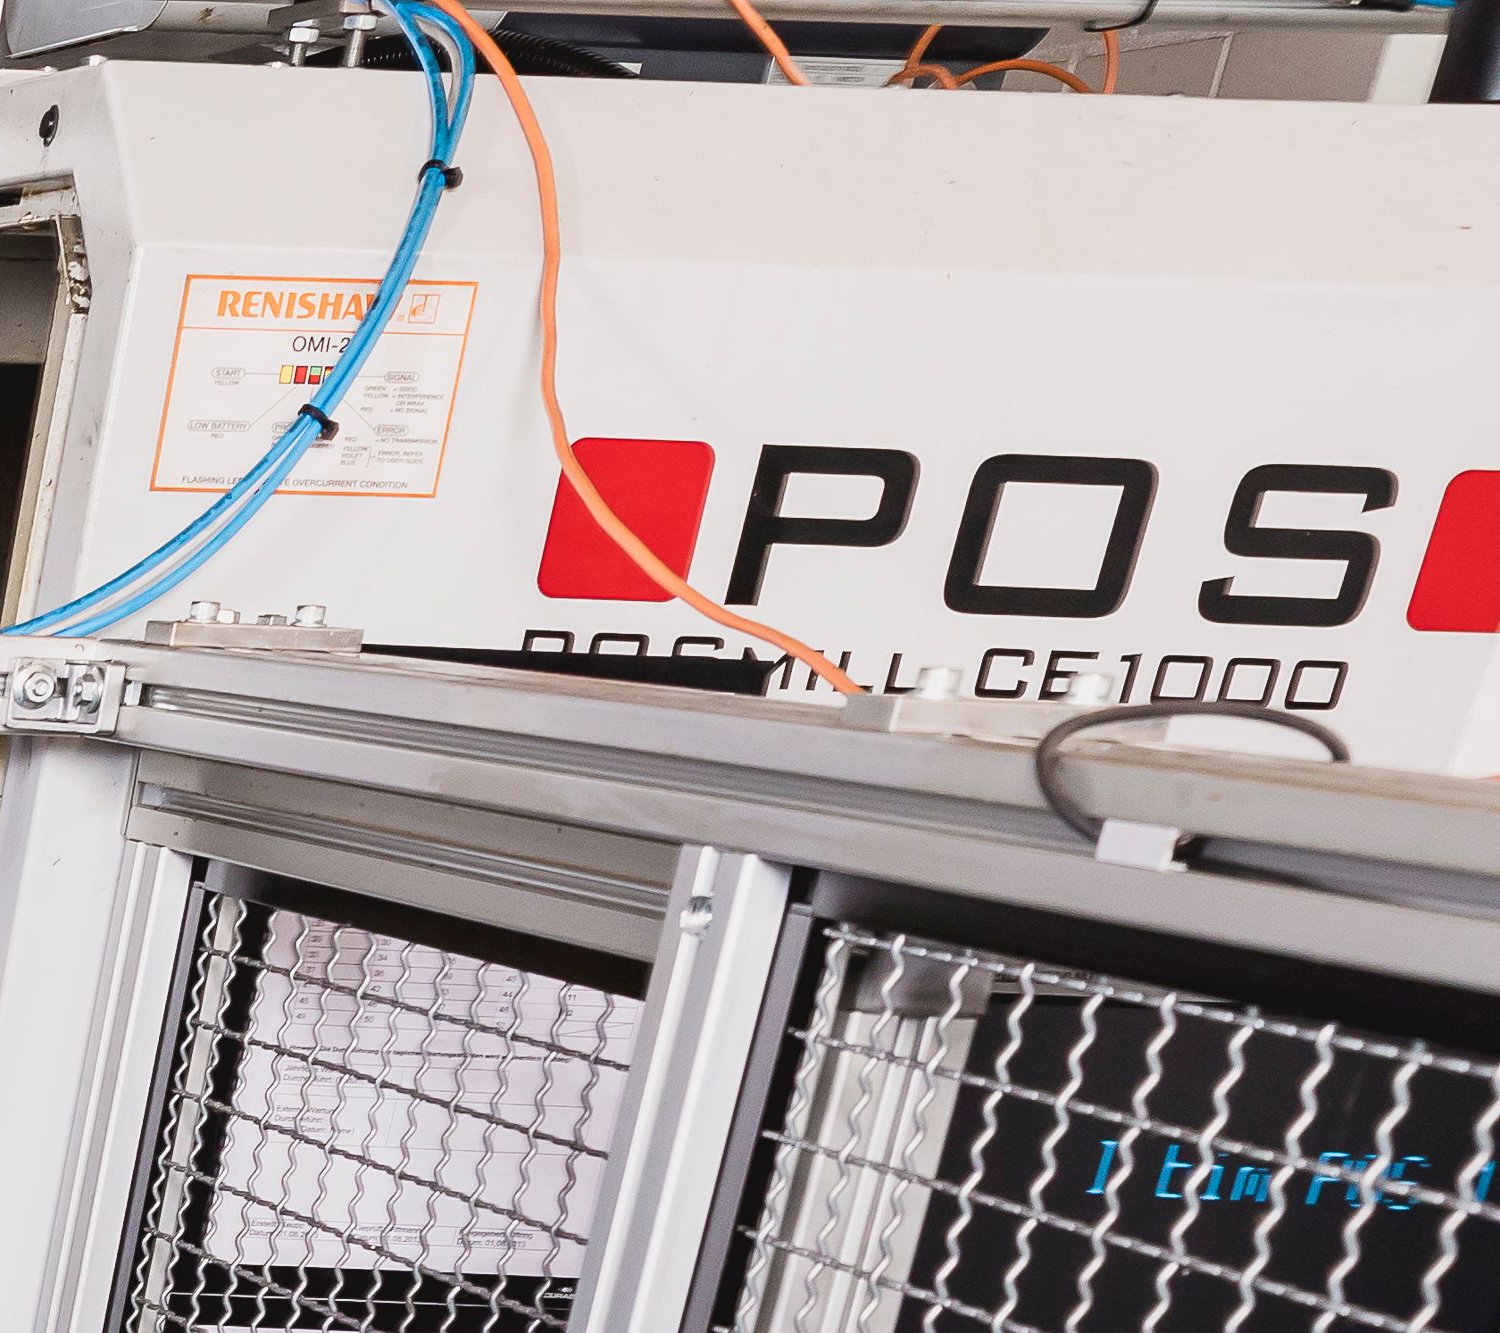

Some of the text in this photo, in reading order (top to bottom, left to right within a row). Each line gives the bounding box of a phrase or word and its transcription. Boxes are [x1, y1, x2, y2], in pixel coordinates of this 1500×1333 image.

[215, 369, 242, 377] START
[211, 422, 247, 430] BATTERY
[182, 476, 408, 489] FLASHING OVERCURRENT CONDITION
[725, 444, 1399, 628] POS
